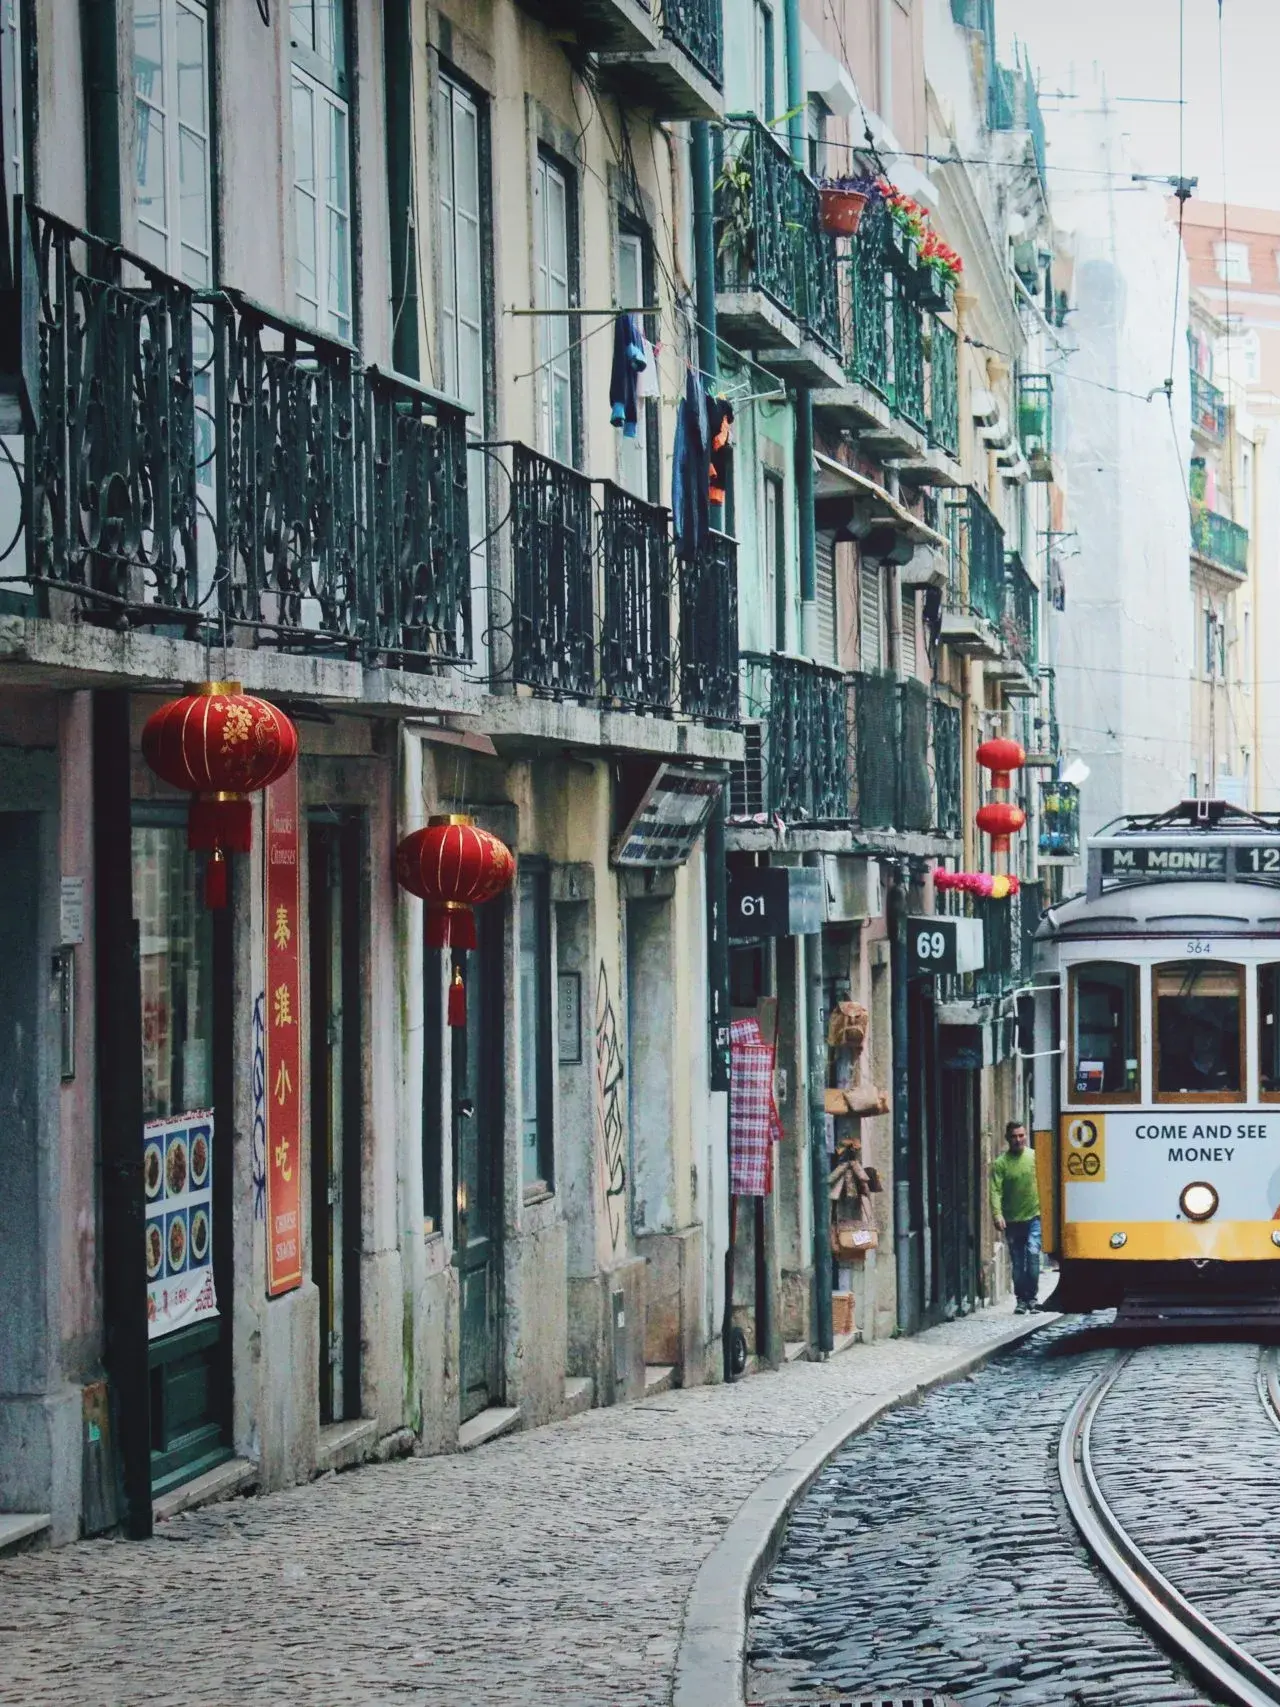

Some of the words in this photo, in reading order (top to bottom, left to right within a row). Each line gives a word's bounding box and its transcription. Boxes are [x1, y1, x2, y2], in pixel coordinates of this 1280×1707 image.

[1147, 850, 1225, 869] MONIZ
[740, 895, 766, 917] 61
[916, 931, 946, 959] 69
[1186, 942, 1211, 954] 564
[1135, 1125, 1188, 1139] COME
[1192, 1125, 1233, 1139] AND
[1236, 1124, 1267, 1139] SEE
[1167, 1147, 1235, 1162] MONEY
